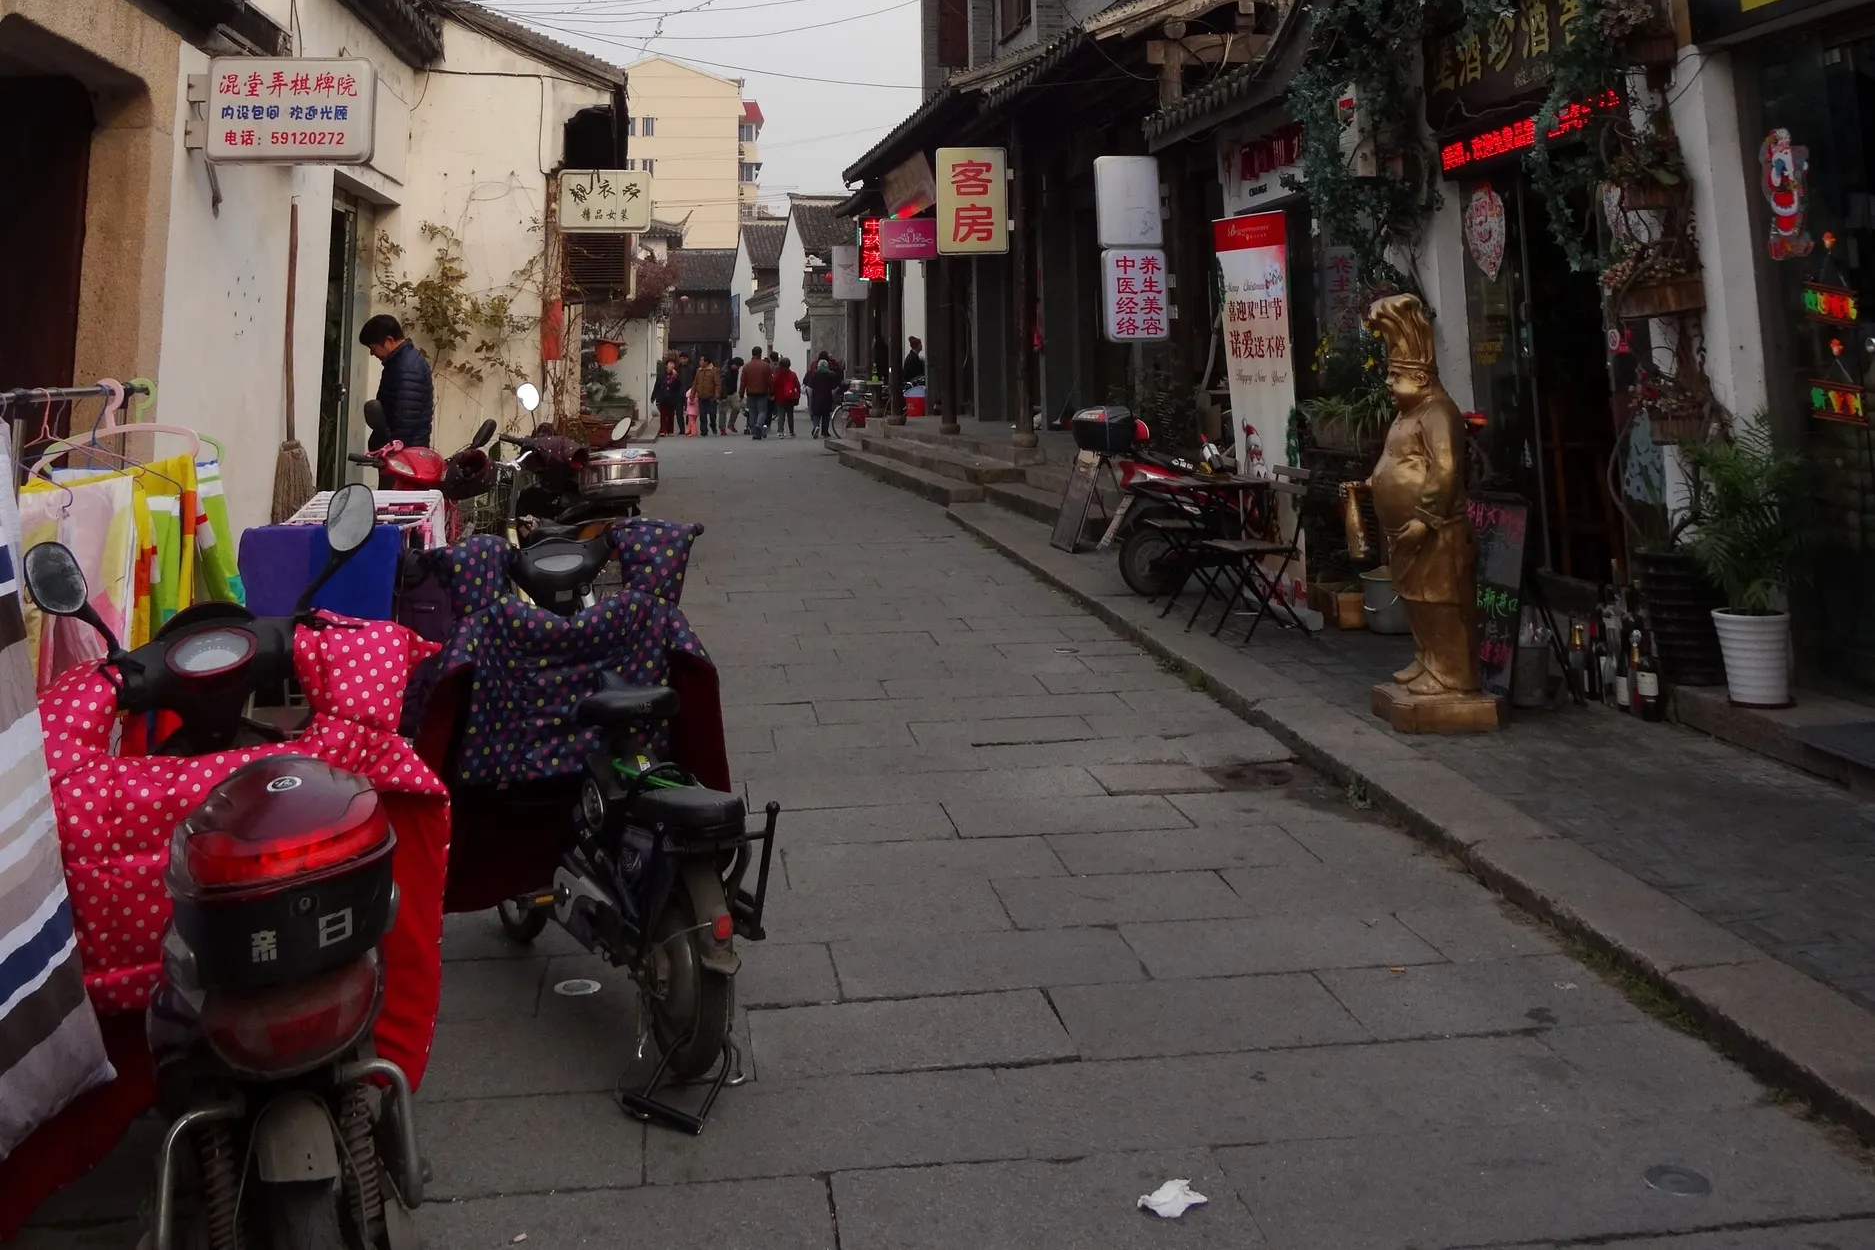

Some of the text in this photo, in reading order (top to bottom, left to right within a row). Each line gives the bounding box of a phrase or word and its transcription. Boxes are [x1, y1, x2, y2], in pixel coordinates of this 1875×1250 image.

[219, 71, 358, 98] 混堂弄棋牌院
[222, 105, 348, 120] 内设包间 欢迎光顾
[581, 207, 629, 222] 精品女装
[951, 159, 995, 242] 客房
[1116, 256, 1140, 336] 中医经络
[1139, 256, 1164, 336] 养生美容
[1230, 330, 1286, 359] 诺爱送不停
